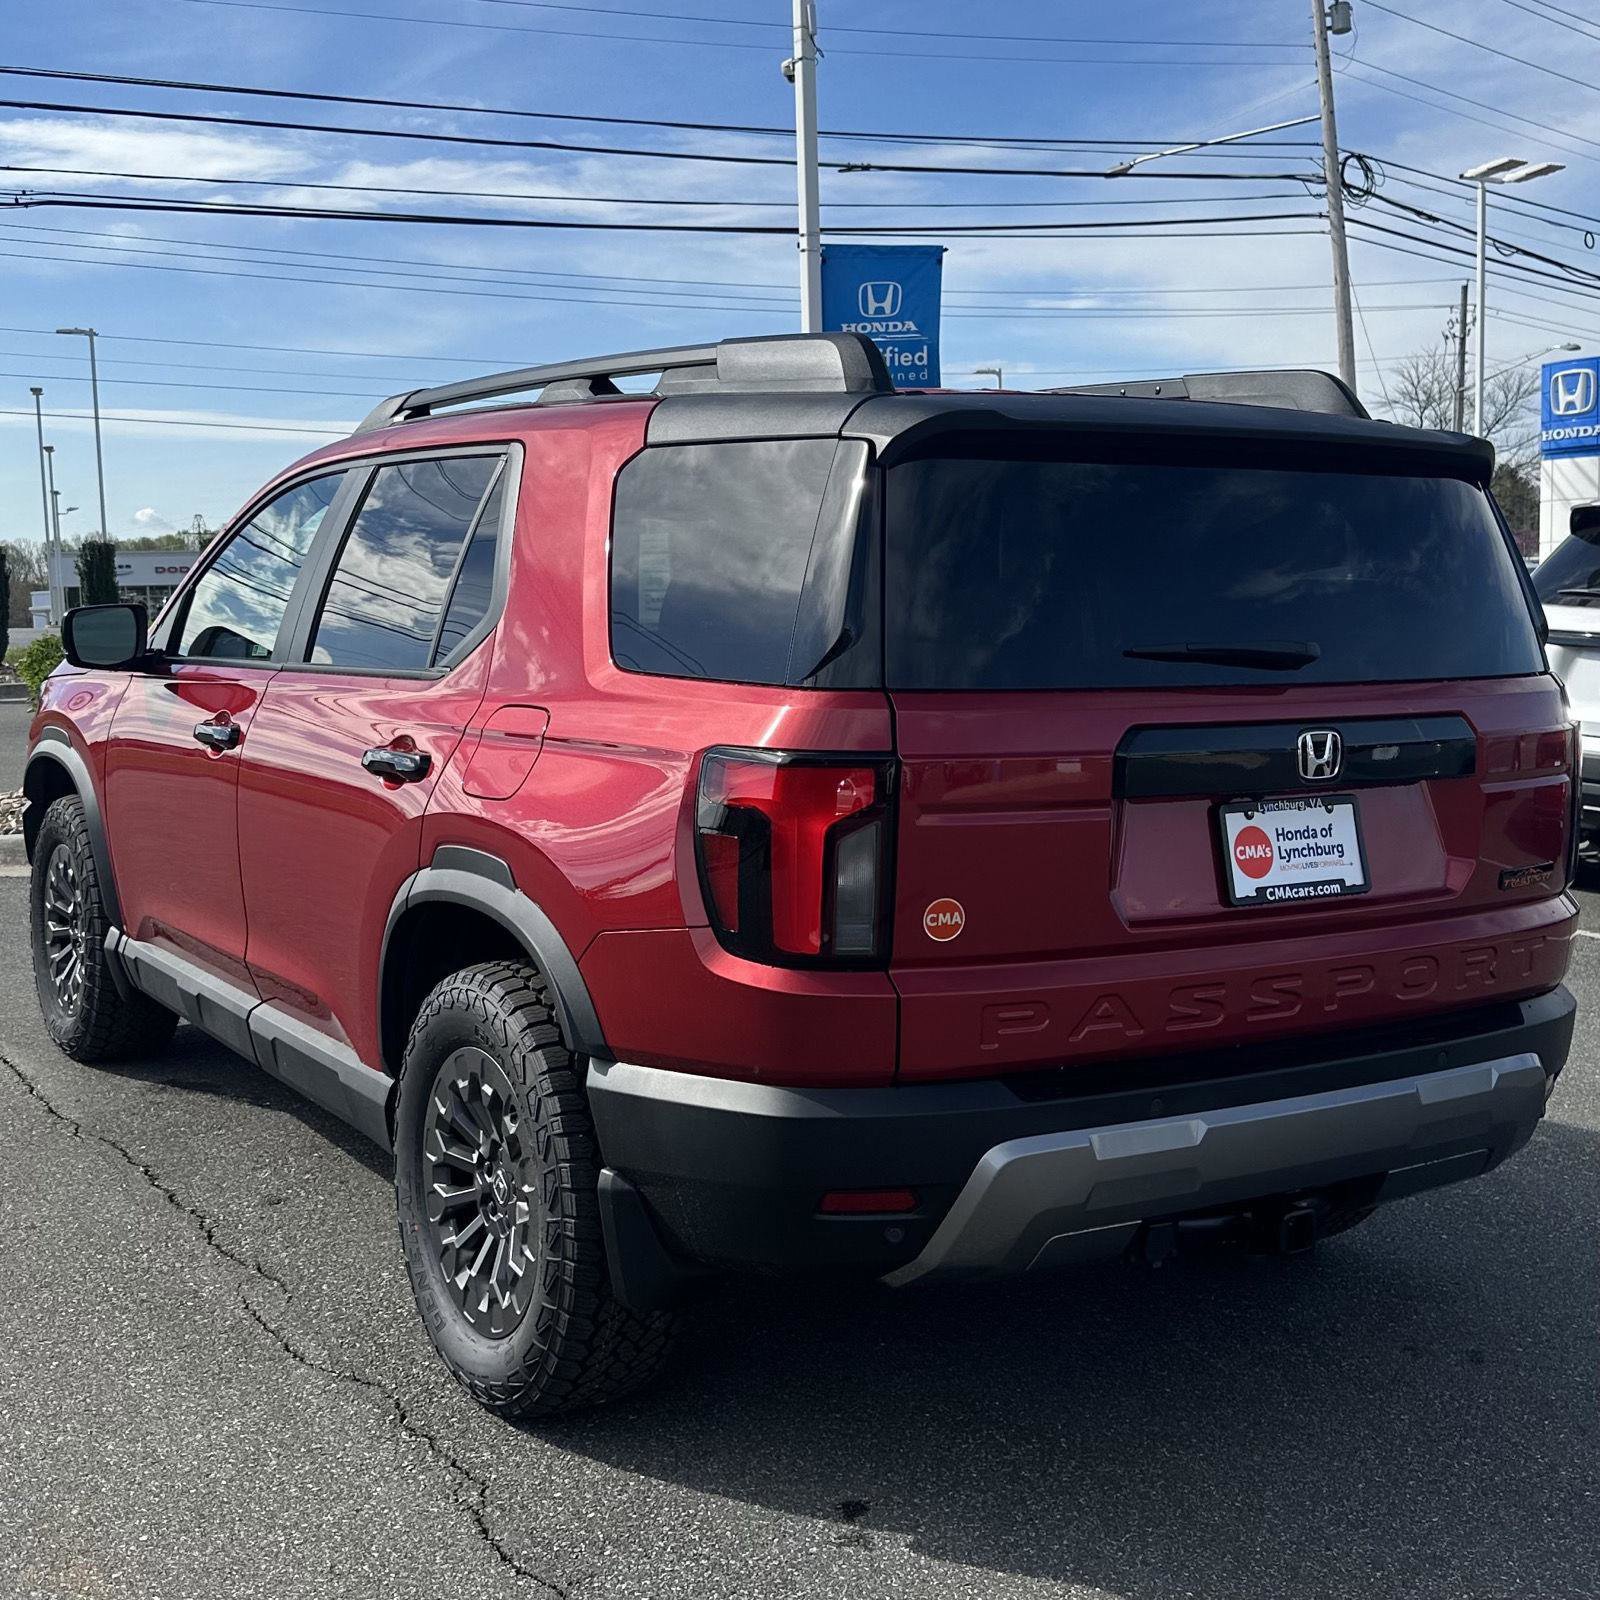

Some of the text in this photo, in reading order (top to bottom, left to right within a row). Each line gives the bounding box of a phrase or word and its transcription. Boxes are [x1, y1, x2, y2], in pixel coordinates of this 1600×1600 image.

[841, 321, 919, 333] HONDA
[880, 345, 928, 367] fied
[891, 368, 928, 381] ned
[1258, 797, 1323, 814] Lynchburg, VA
[1275, 822, 1333, 842] Honda of
[1236, 844, 1272, 860] CMA's
[1278, 842, 1345, 863] Lynchburg
[1266, 884, 1341, 901] CMAcars.com
[926, 911, 962, 927] CMA
[978, 935, 1547, 1050] PASSPORT
